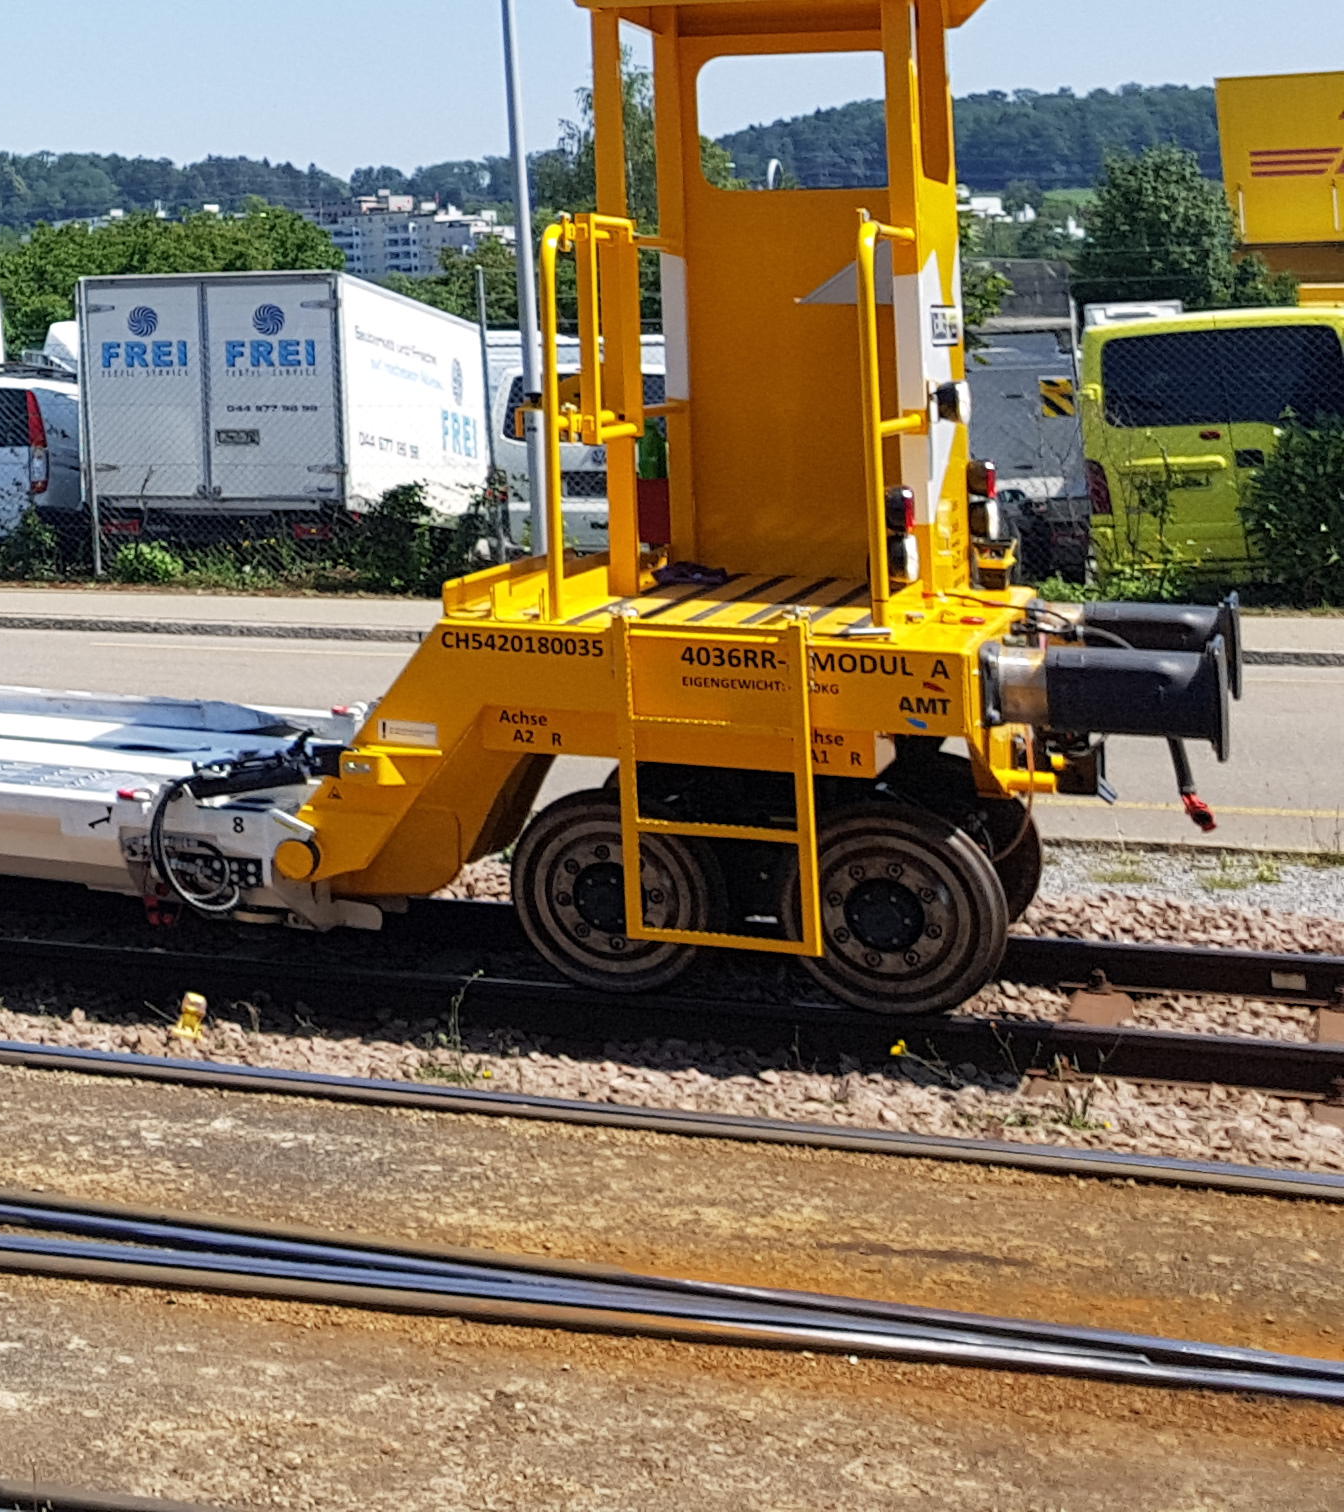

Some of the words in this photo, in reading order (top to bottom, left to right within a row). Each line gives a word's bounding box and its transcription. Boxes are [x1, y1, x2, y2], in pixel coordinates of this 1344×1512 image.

[101, 340, 188, 369] FREI
[225, 339, 316, 368] FREI
[441, 409, 478, 460] FREI
[441, 631, 604, 658] CH5420180035
[681, 646, 787, 670] 4036RR-
[812, 651, 914, 677] MODUL
[930, 659, 951, 680] A
[898, 696, 952, 716] AMT
[499, 709, 548, 727] Achse
[513, 729, 535, 745] A2
[551, 732, 563, 747] R
[813, 728, 845, 746] hse
[850, 751, 863, 767] R
[232, 816, 245, 834] 8
